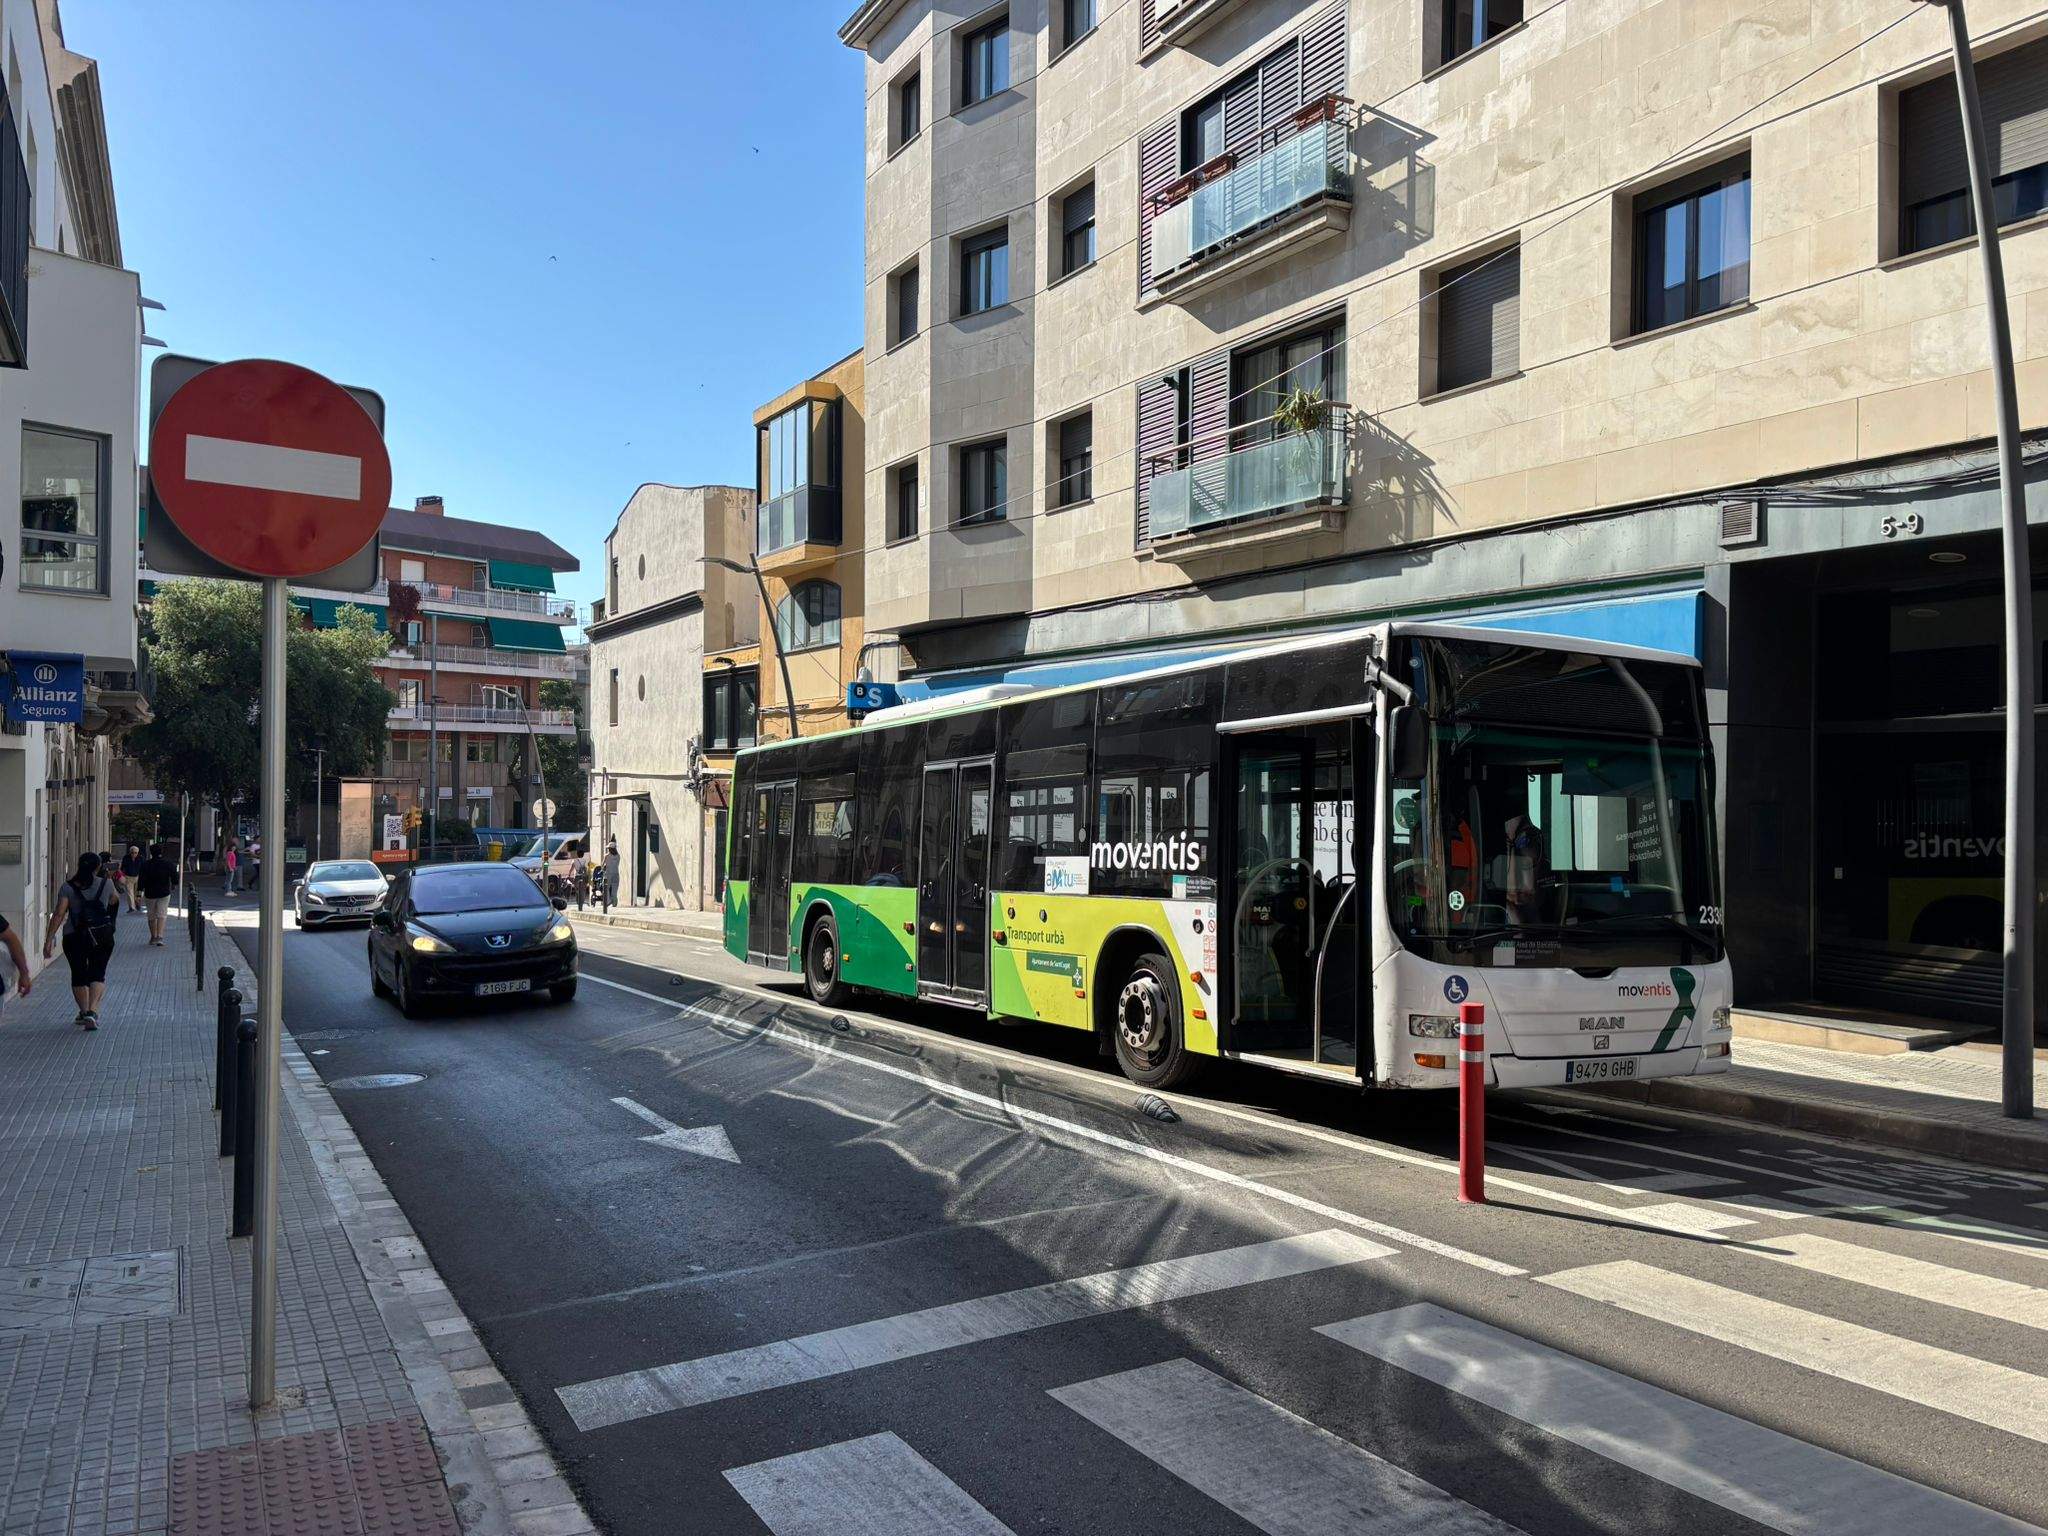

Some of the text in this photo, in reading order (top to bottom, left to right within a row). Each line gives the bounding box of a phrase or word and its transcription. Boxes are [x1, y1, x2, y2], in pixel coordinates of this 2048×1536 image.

[1880, 513, 1918, 535] 5-9
[14, 686, 77, 702] Allianz
[22, 704, 67, 717] Seguros
[1091, 831, 1200, 871] moventis
[1007, 926, 1065, 945] Transport urbà
[483, 983, 507, 994] 2169
[1618, 982, 1671, 997] moventis
[1579, 1016, 1625, 1031] MAN
[1576, 1060, 1634, 1079] 9479 GHB
